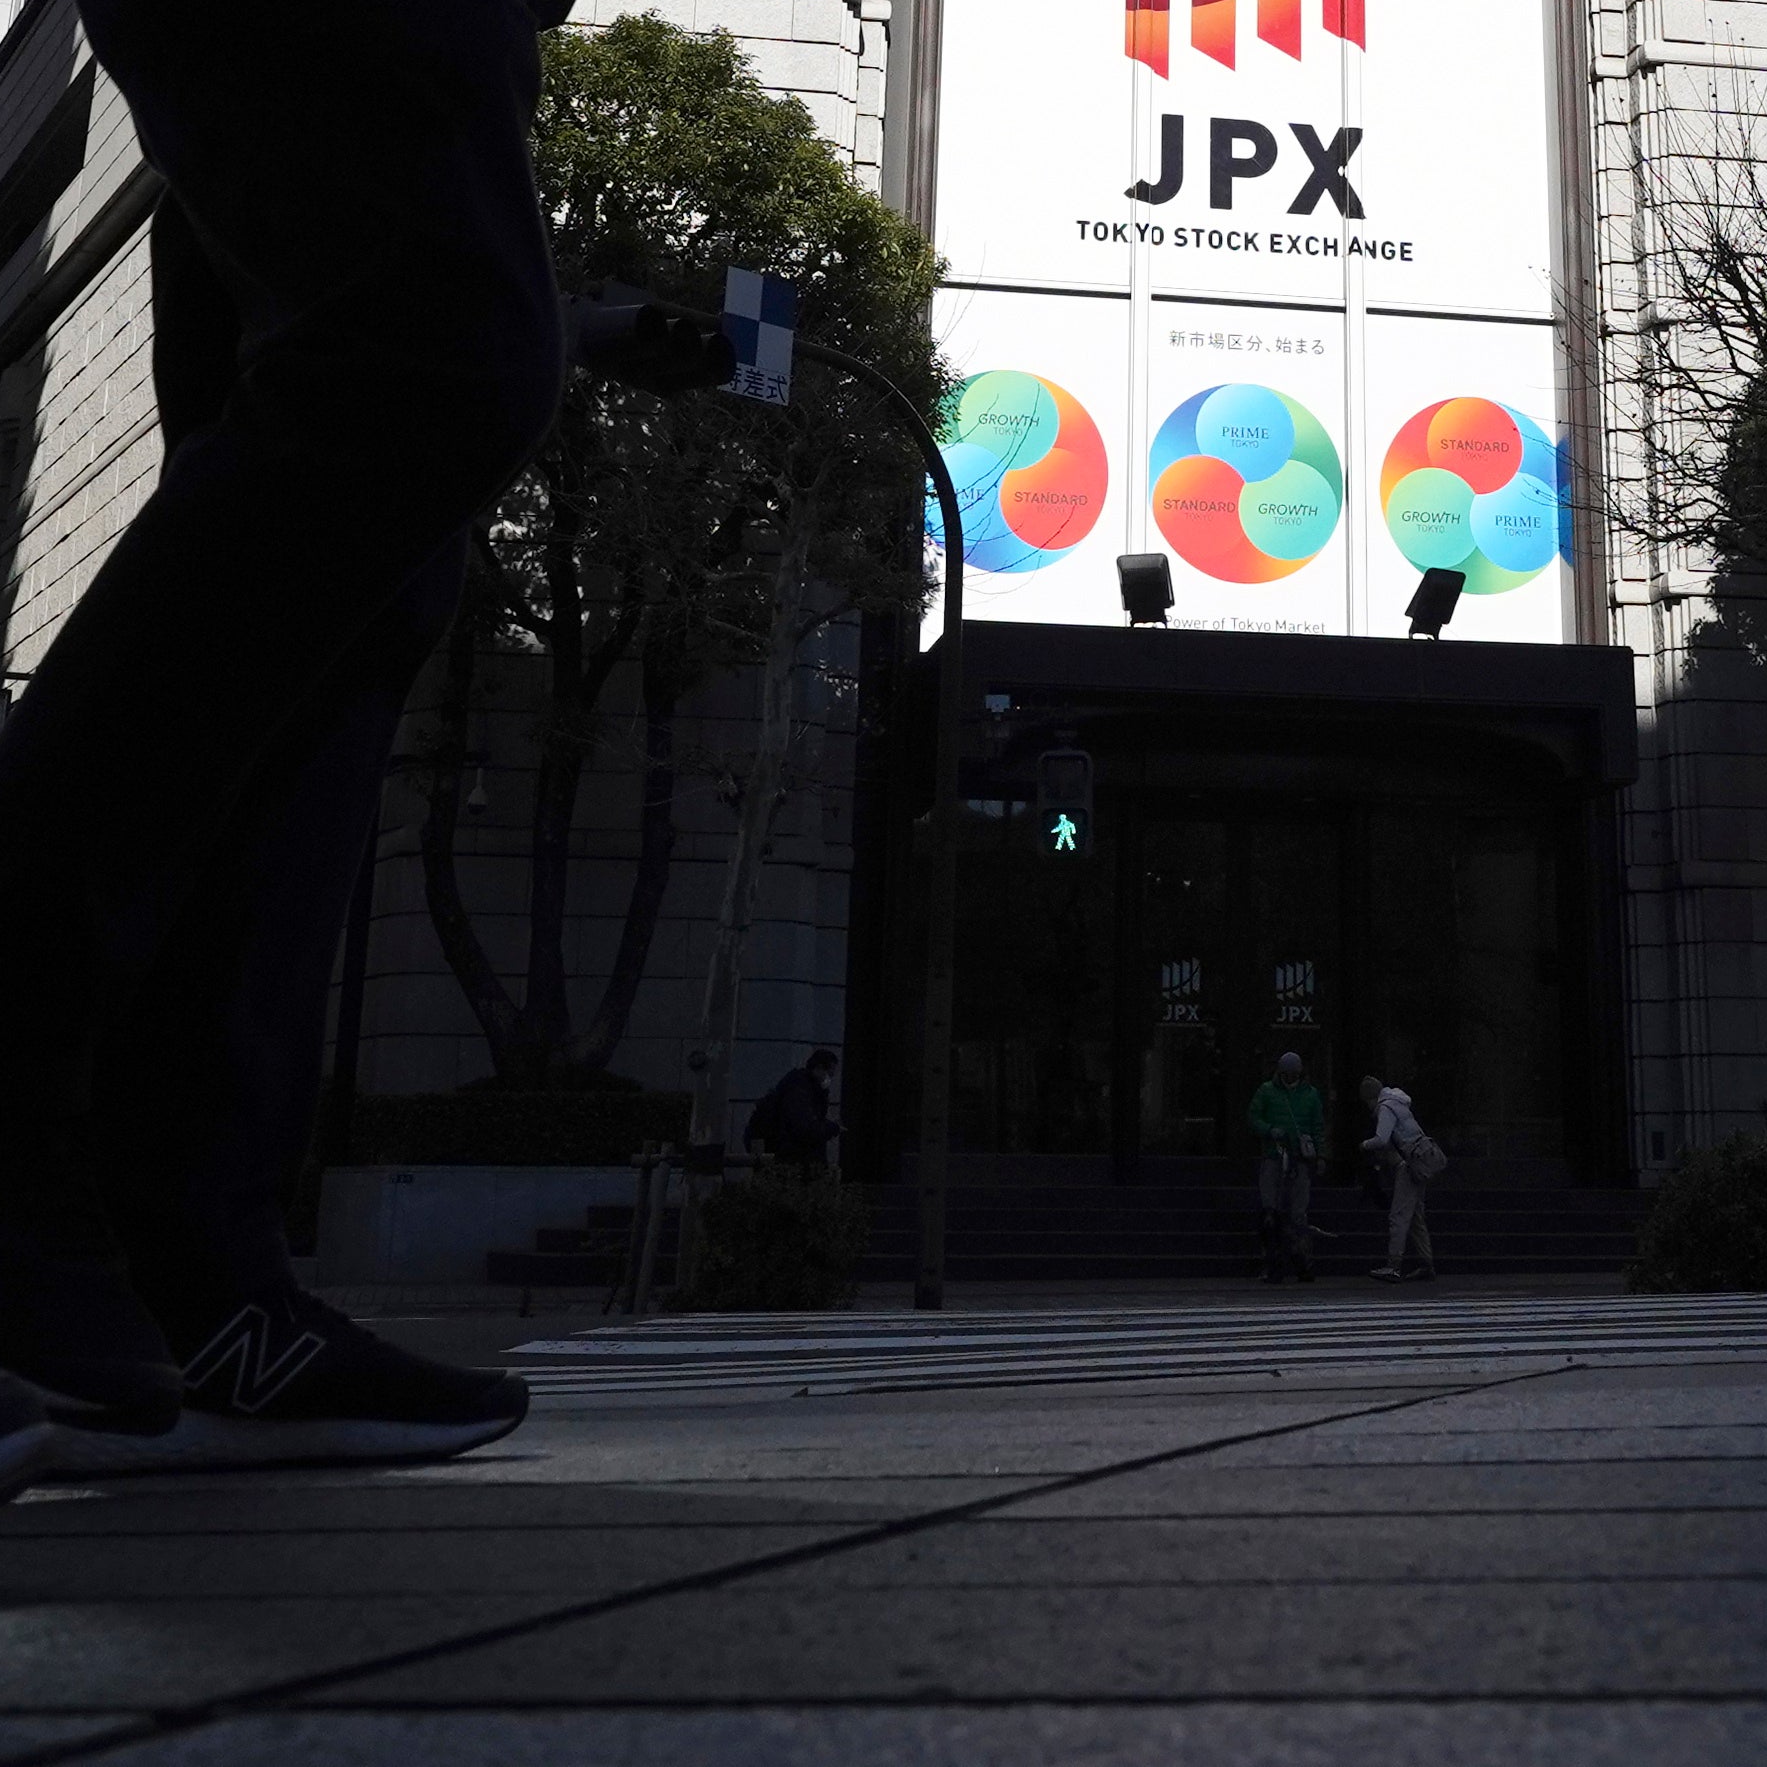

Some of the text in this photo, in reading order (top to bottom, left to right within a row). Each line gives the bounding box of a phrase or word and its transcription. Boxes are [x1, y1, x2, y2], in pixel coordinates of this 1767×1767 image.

[1123, 113, 1367, 220] JPX
[1076, 220, 1414, 263] TOKYO STOCK EXCHANGE
[1169, 330, 1325, 355] 新市場区分、始まる
[979, 413, 1040, 427] GROWTH
[993, 426, 1023, 437] TOKYO
[1222, 426, 1271, 440] PRIME
[1231, 439, 1260, 449] TOKYO
[1440, 439, 1510, 453] STANDARD
[1014, 491, 1088, 506] STANDARD
[1163, 498, 1235, 513] STANDARD
[1258, 503, 1318, 516] GROWTH
[1273, 516, 1302, 526] TOKYO
[1401, 510, 1461, 524] GROWTH
[1495, 515, 1541, 528] PRIME
[1417, 525, 1446, 534] TOKYO
[1504, 528, 1532, 538] TOKYO
[1166, 615, 1325, 634] Power of Tokyo Market
[1163, 1004, 1200, 1022] JPX
[1276, 1006, 1314, 1023] JPX
